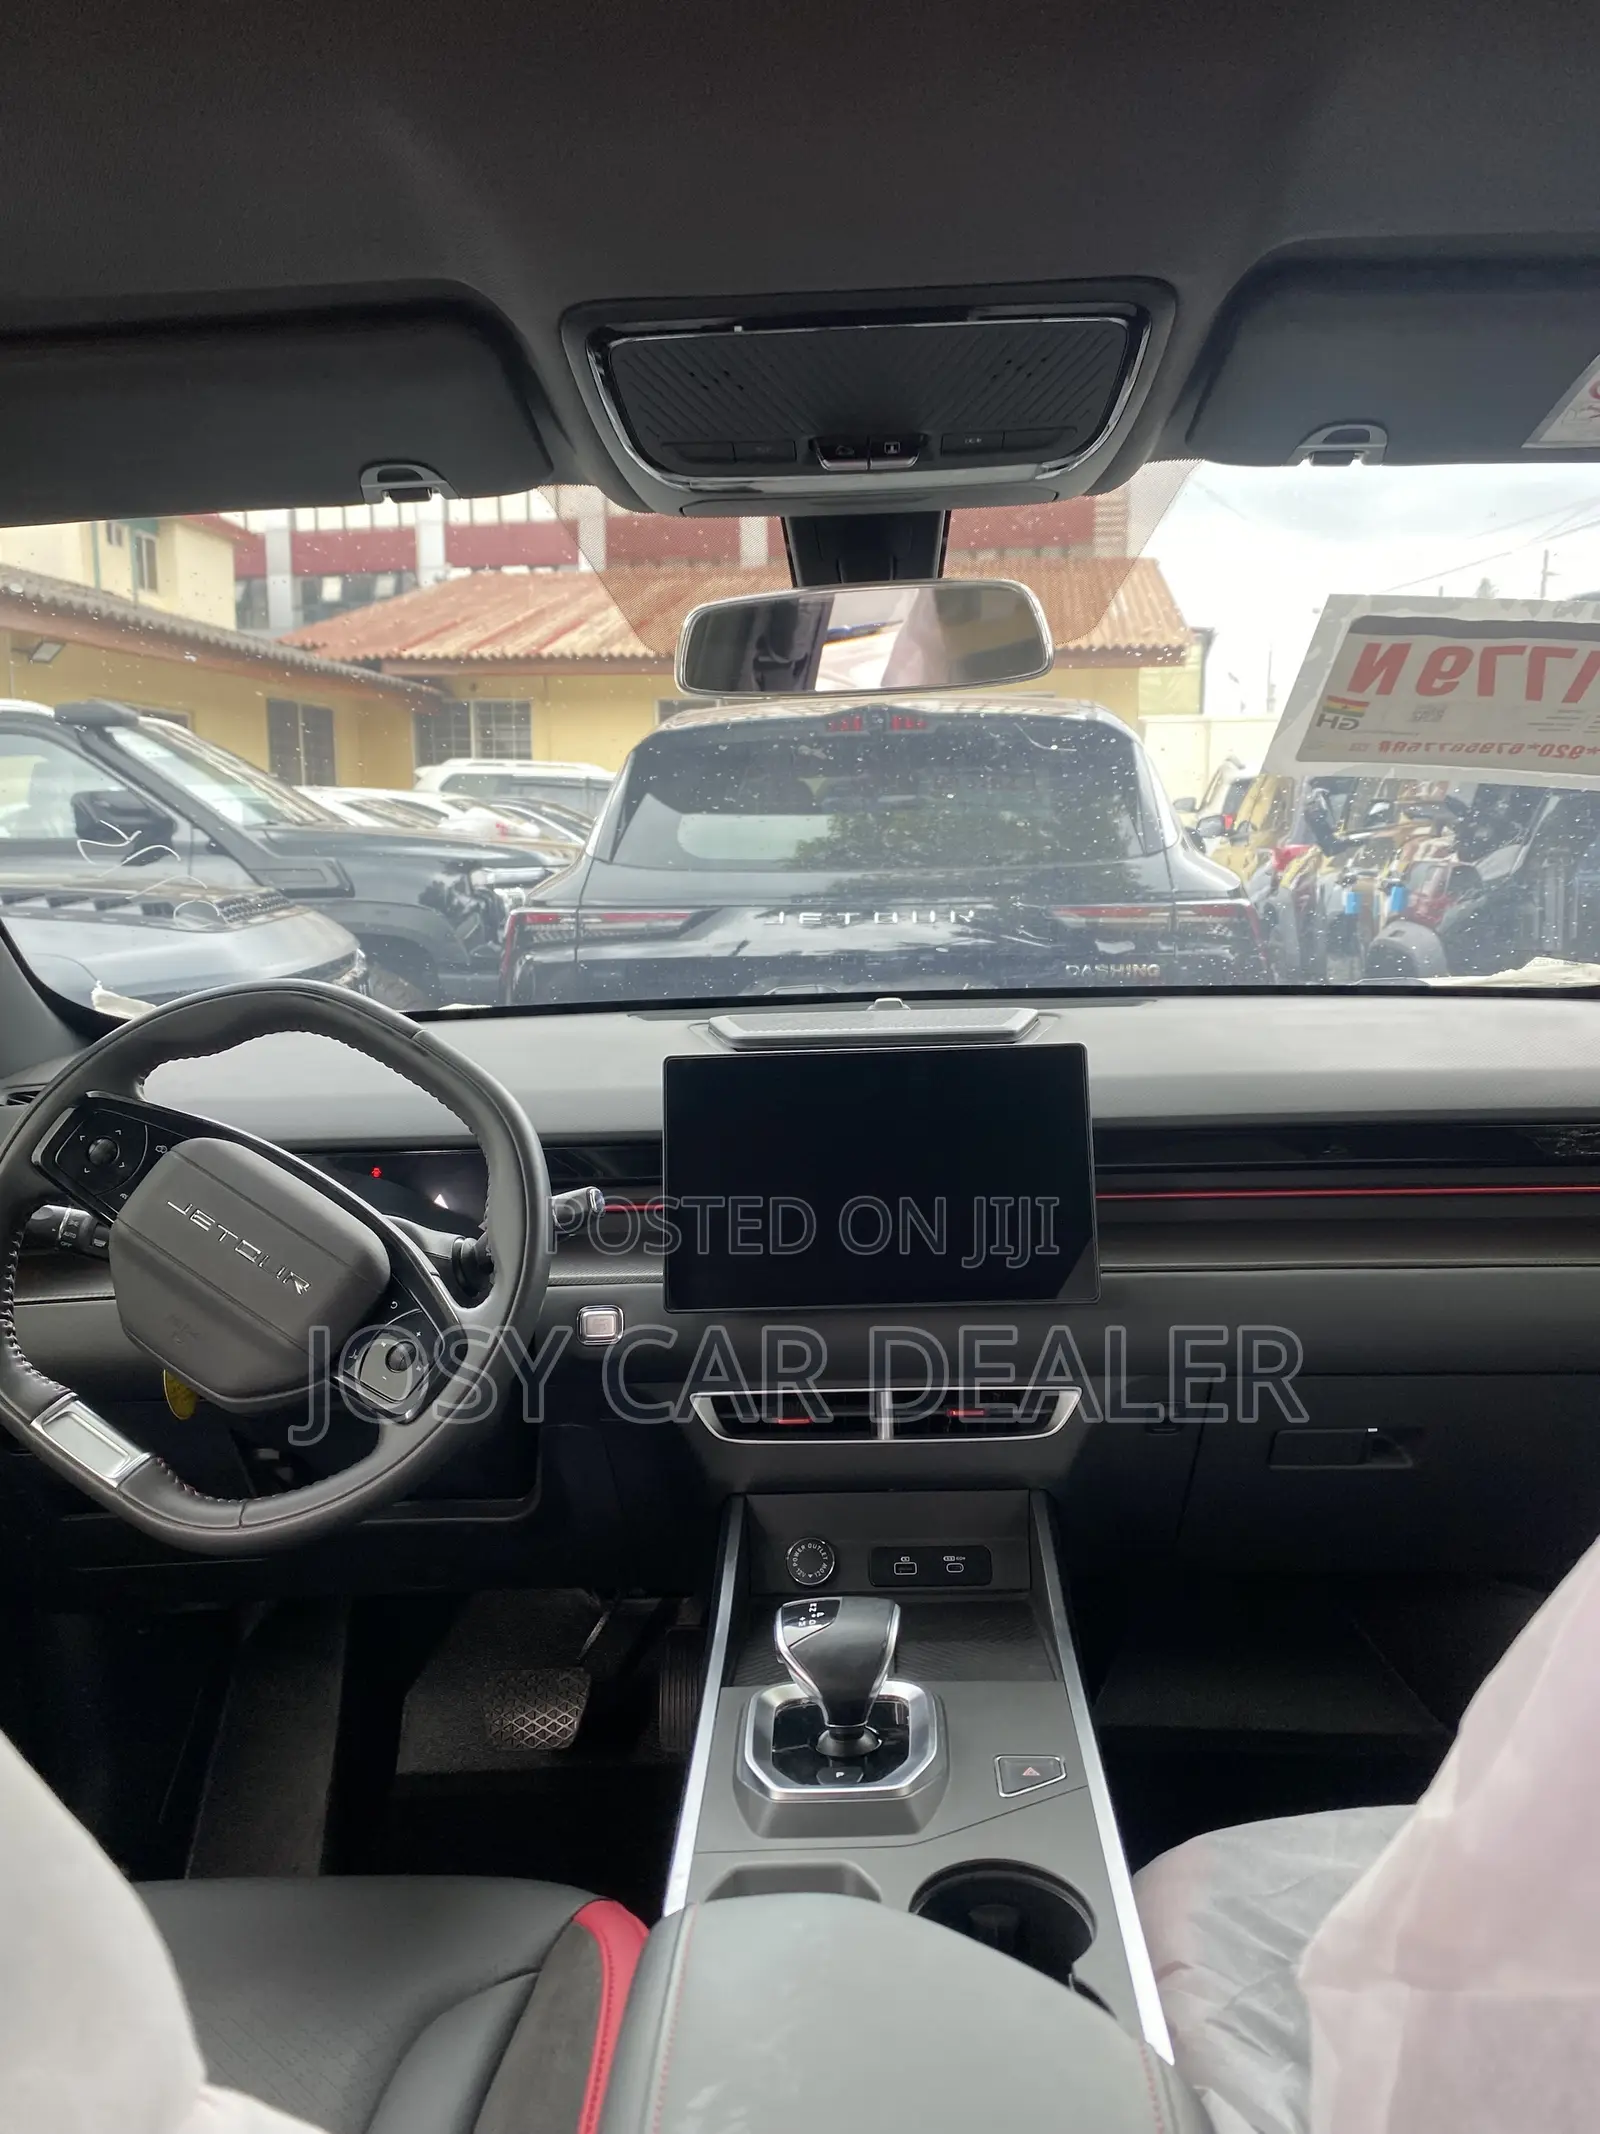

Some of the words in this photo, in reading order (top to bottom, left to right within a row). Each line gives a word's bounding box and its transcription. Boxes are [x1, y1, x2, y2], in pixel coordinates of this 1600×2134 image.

[167, 1201, 311, 1295] JETOUR
[792, 1544, 806, 1567] POWER
[807, 1542, 828, 1560] OUTLET
[795, 1567, 807, 1578] 12V
[814, 1562, 828, 1578] 120W
